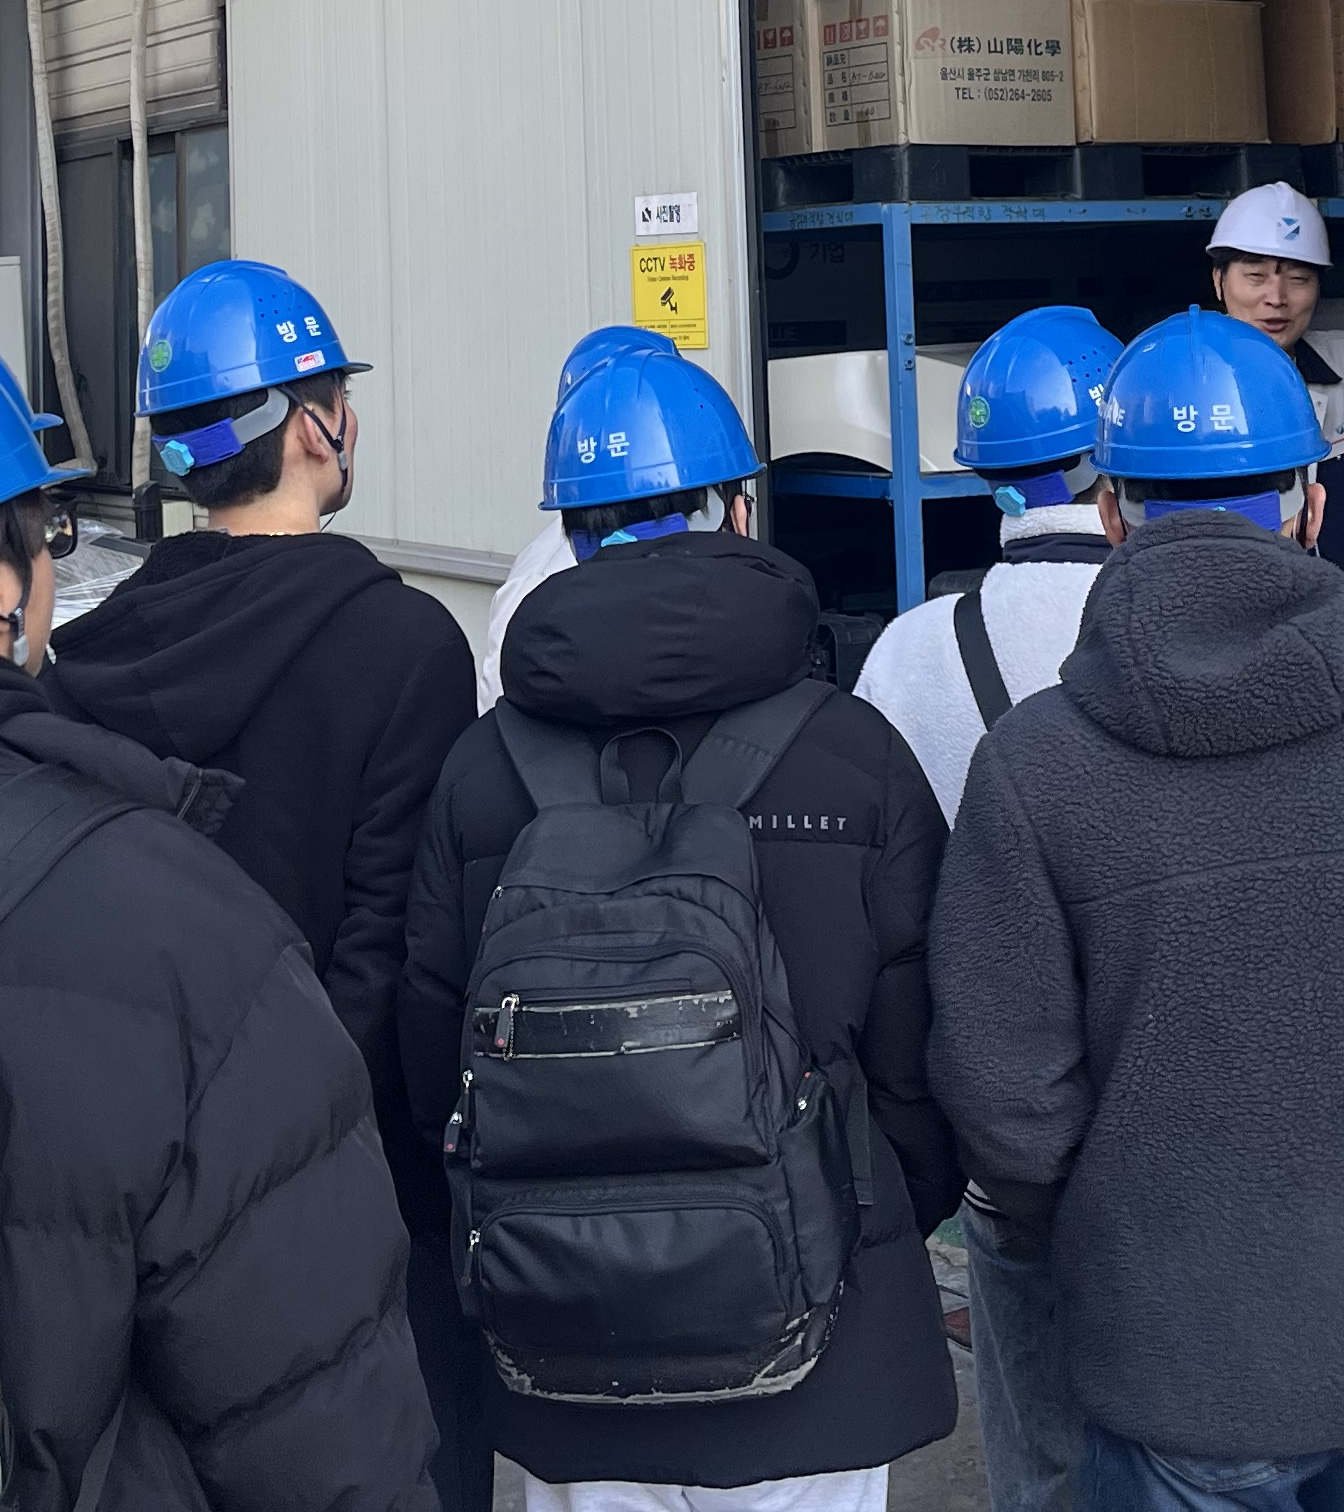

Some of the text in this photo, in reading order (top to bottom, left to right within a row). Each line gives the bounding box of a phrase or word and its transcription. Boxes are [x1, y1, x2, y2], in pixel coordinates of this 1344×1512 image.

[987, 38, 1061, 57] 山陽化學
[940, 67, 964, 81] 울산시
[967, 67, 990, 81] 울주군
[954, 87, 974, 100] TEL
[984, 88, 1053, 102] (052)264-2605
[639, 253, 696, 273] CCTV 녹화중
[748, 814, 846, 830] MILLET
